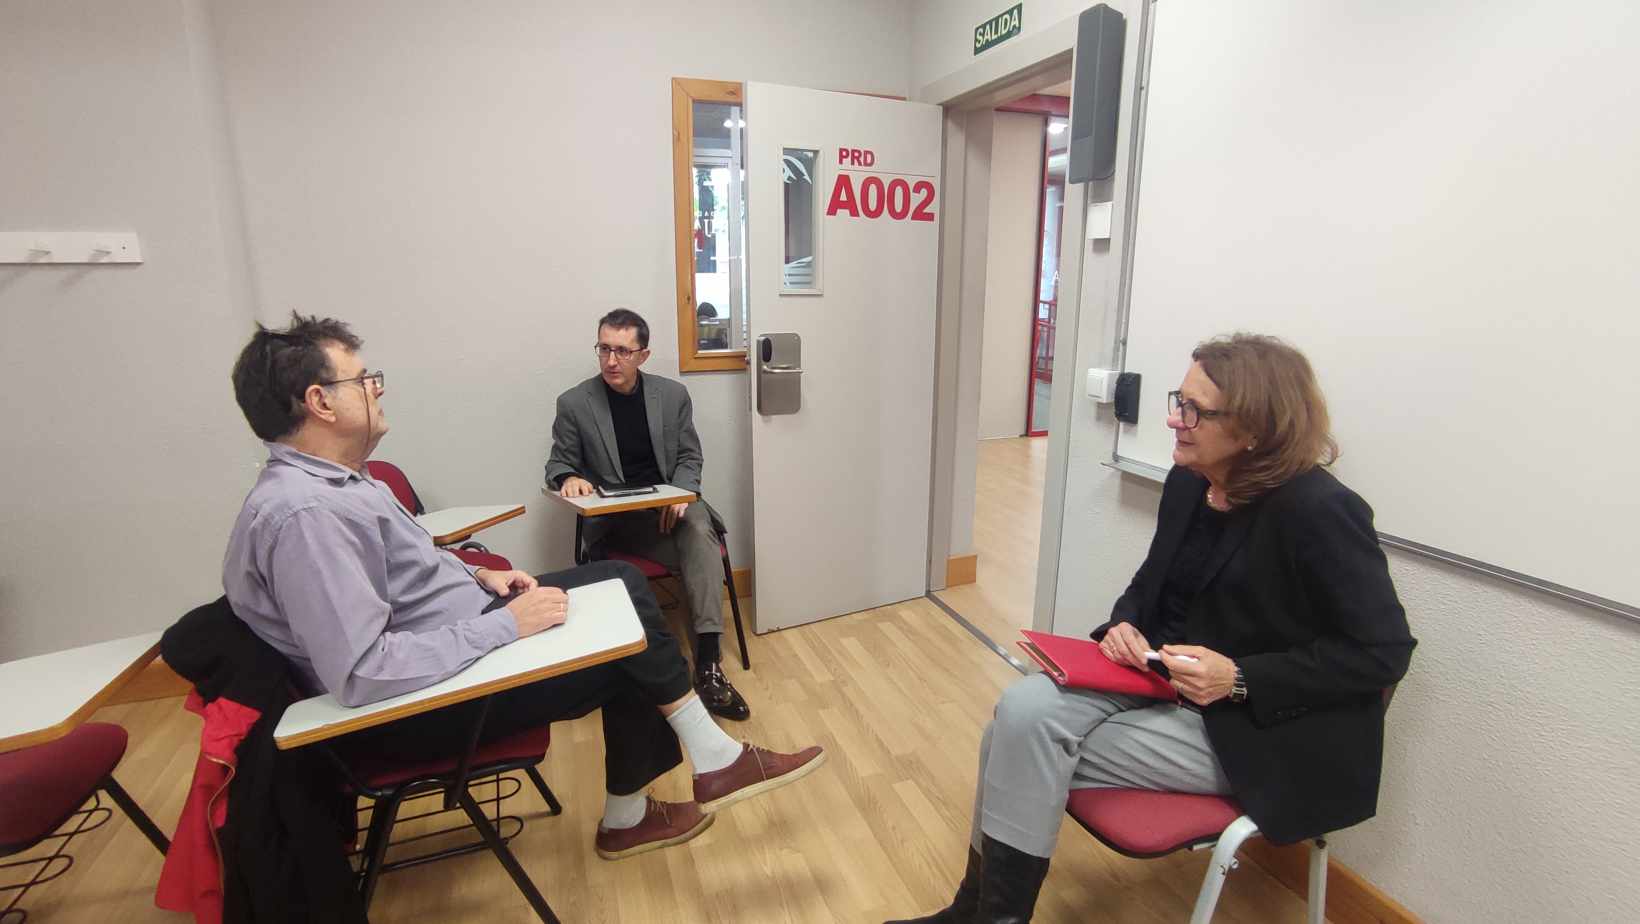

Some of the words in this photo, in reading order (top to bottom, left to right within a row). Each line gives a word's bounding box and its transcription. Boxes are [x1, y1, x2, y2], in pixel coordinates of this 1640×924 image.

[976, 8, 1019, 48] SALIDA
[838, 147, 875, 167] PRD
[826, 173, 936, 222] A002
